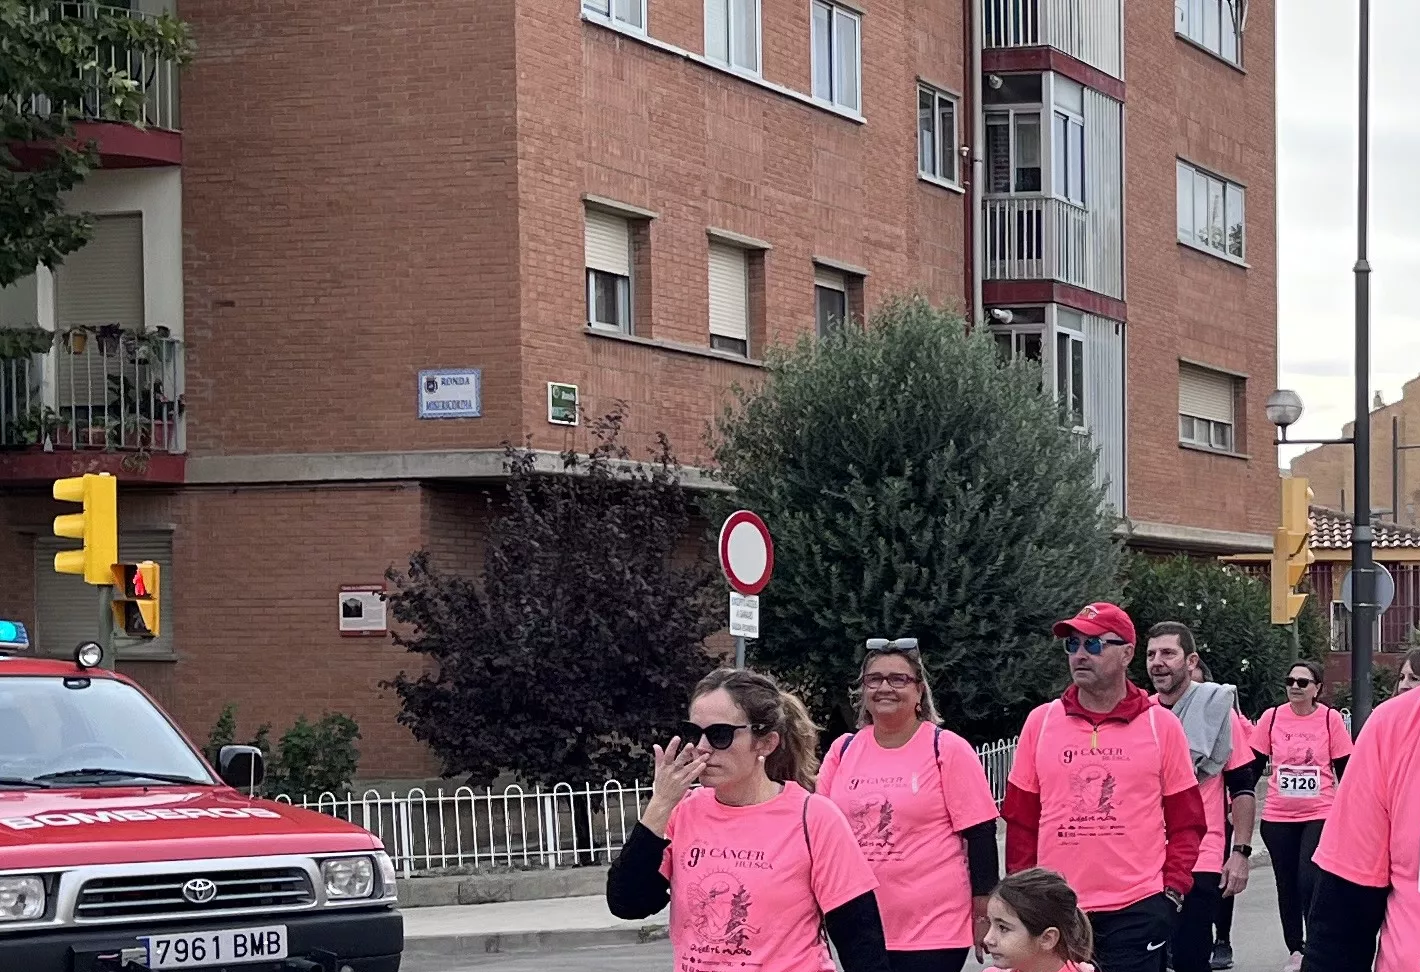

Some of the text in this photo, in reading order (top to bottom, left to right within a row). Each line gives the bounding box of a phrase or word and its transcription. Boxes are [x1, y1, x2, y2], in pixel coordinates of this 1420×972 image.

[441, 376, 470, 386] RONDA
[1280, 776, 1316, 790] 3120
[1, 807, 281, 830] BOMBEROS
[709, 846, 765, 861] CÁNCER
[156, 931, 281, 965] 7961 BMB
